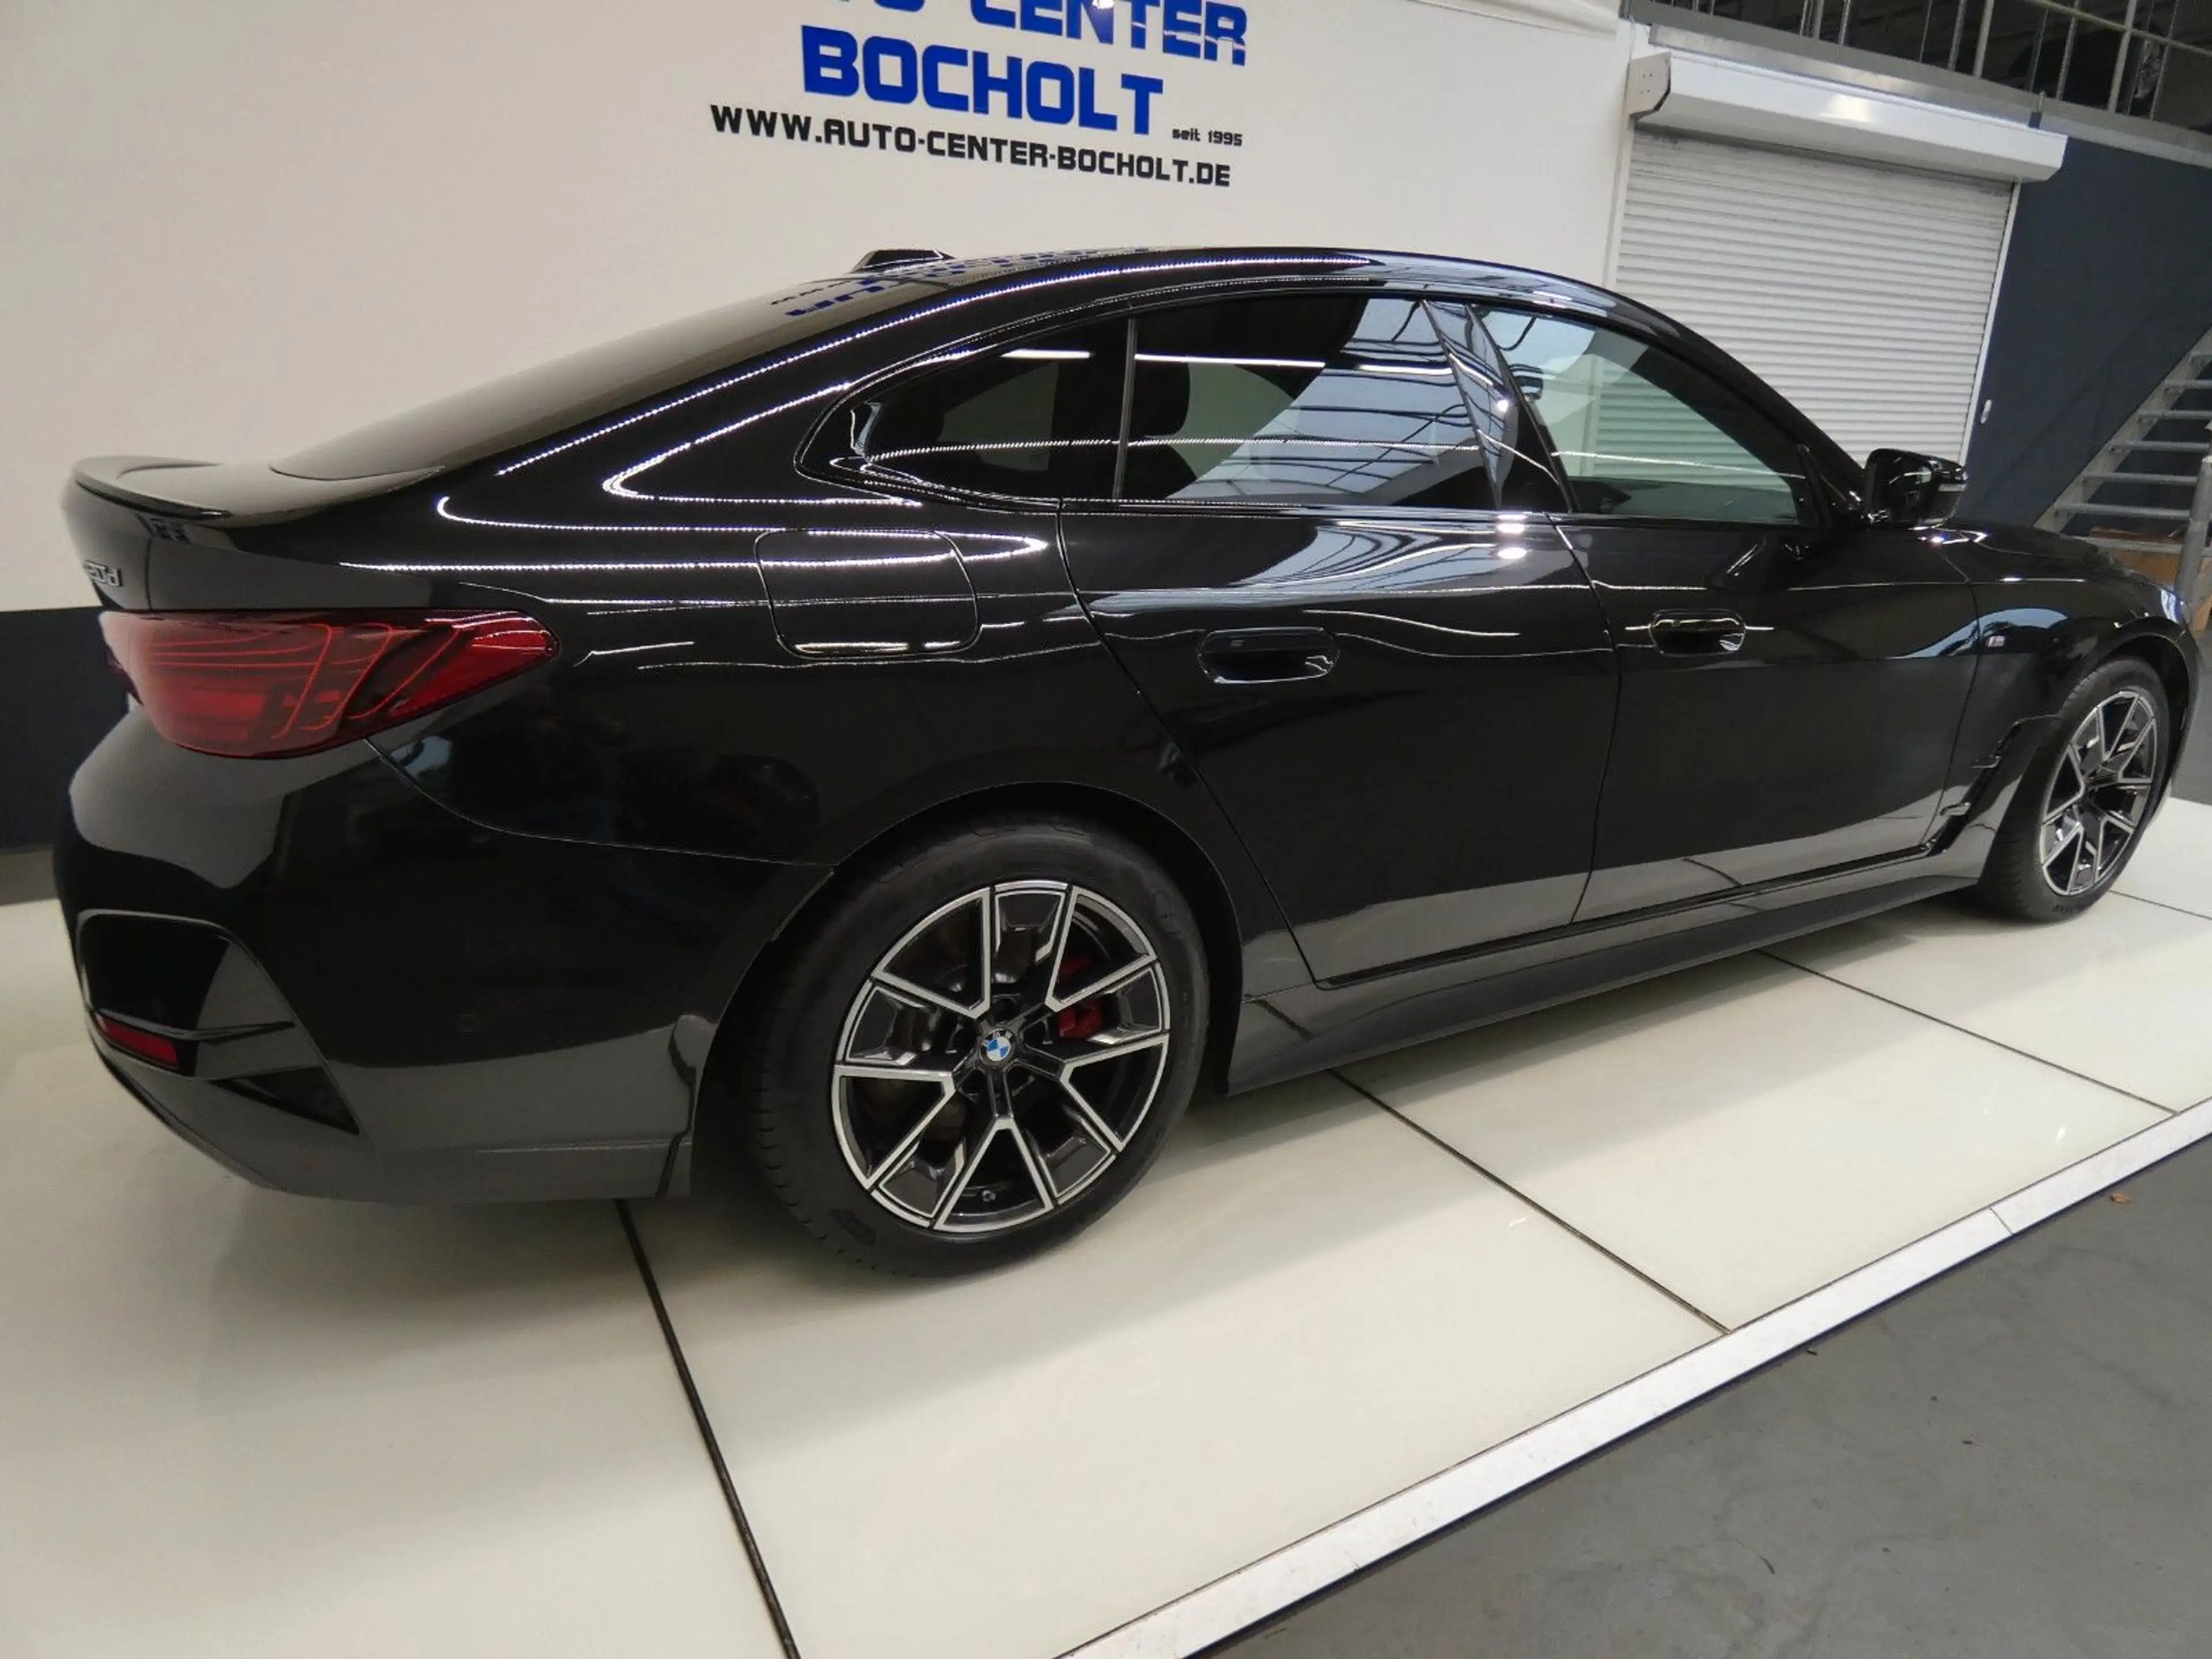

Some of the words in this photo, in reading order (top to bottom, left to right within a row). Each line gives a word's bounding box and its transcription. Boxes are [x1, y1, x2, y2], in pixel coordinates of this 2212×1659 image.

[801, 25, 1164, 135] BOCHOLT
[710, 104, 1231, 187] WWW.AUTO-CENTER-BOCHOLT.DE
[1172, 128, 1202, 142] seit
[1208, 130, 1243, 146] 1995
